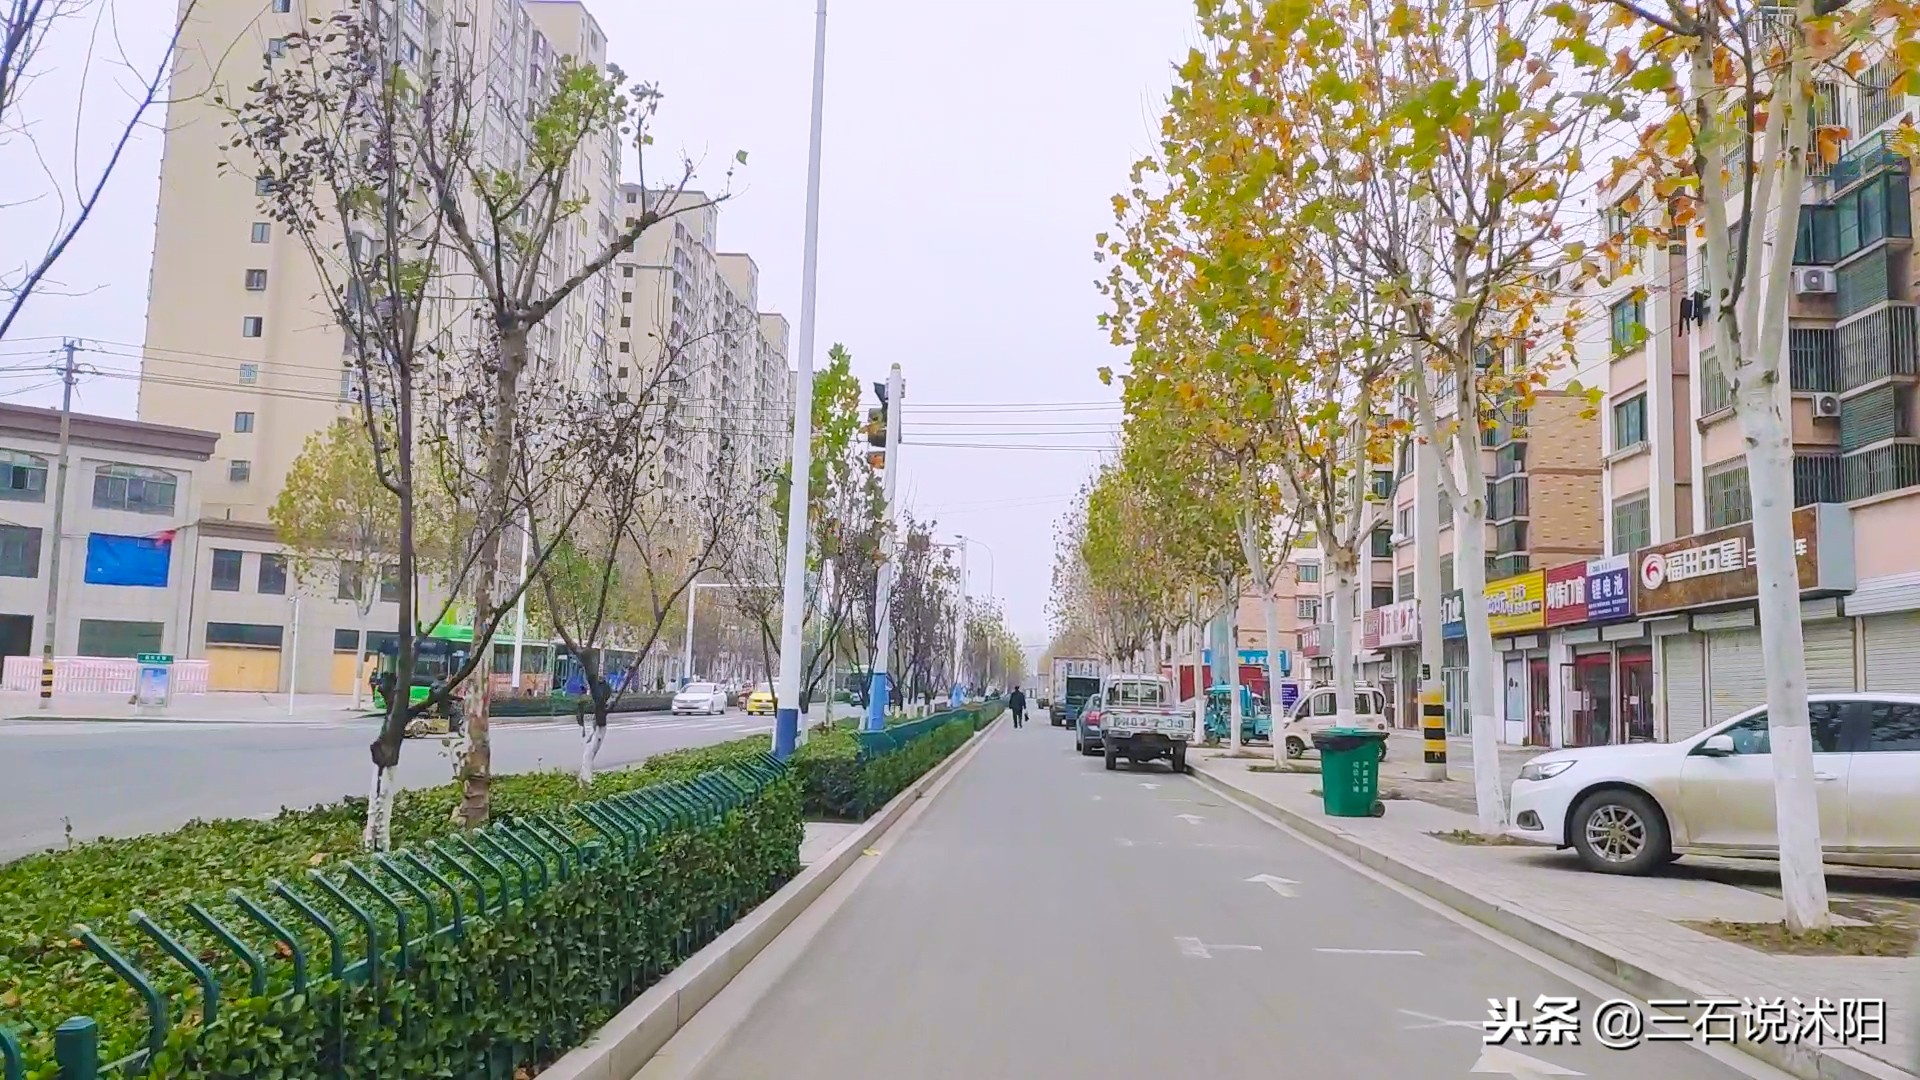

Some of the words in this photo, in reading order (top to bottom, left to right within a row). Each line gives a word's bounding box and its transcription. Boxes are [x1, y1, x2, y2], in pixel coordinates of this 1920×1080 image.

[1664, 537, 1744, 582] 福田五星
[1591, 573, 1623, 600] 锂电池
